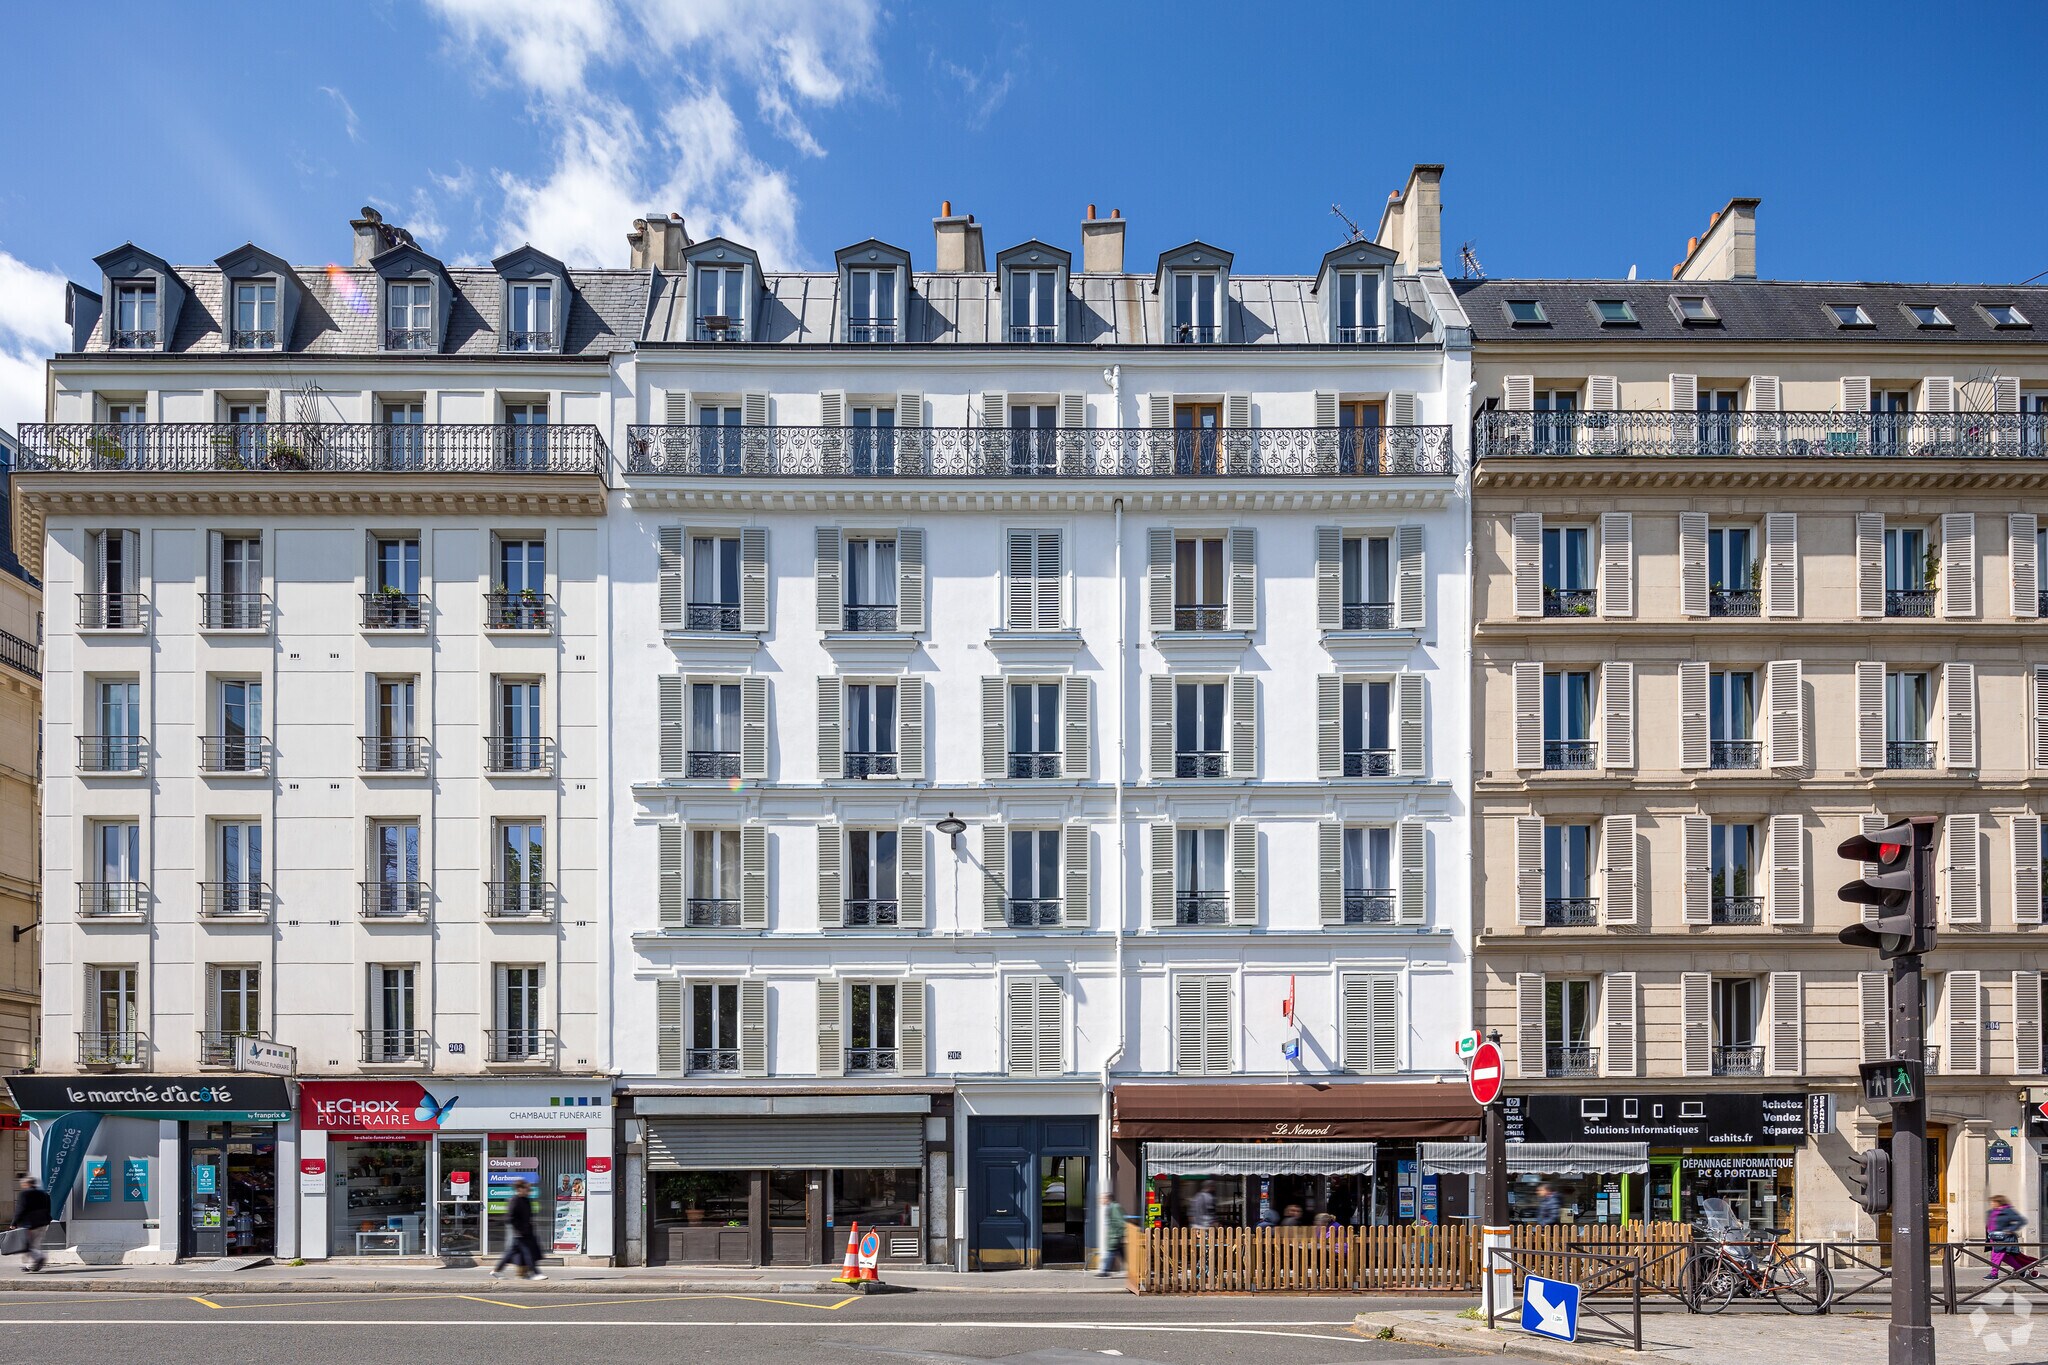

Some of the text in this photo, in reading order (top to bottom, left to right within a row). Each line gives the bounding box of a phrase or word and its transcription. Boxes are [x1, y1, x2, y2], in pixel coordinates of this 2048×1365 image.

[1985, 1021, 1999, 1030] 204
[449, 1043, 464, 1052] 208
[948, 1051, 961, 1059] 206
[66, 1087, 87, 1103] le
[87, 1086, 160, 1103] marché
[190, 1085, 233, 1103] côté
[1762, 1100, 1803, 1109] Achetez
[317, 1114, 410, 1126] FUNERAIRE
[509, 1111, 602, 1120] CHAMBAULT FUNÉRAIRE
[1763, 1113, 1802, 1122] Vendez
[1271, 1123, 1331, 1135] Le Nemrod
[1583, 1124, 1699, 1135] Solutions Informatiques
[1762, 1125, 1804, 1136] Réparez
[1709, 1133, 1753, 1143] cashits.fr
[490, 1159, 521, 1168] Obsèques
[1682, 1157, 1794, 1169] DÉPANNAGE INFORMATIQUE
[1698, 1169, 1778, 1178] PC & PORTABLE
